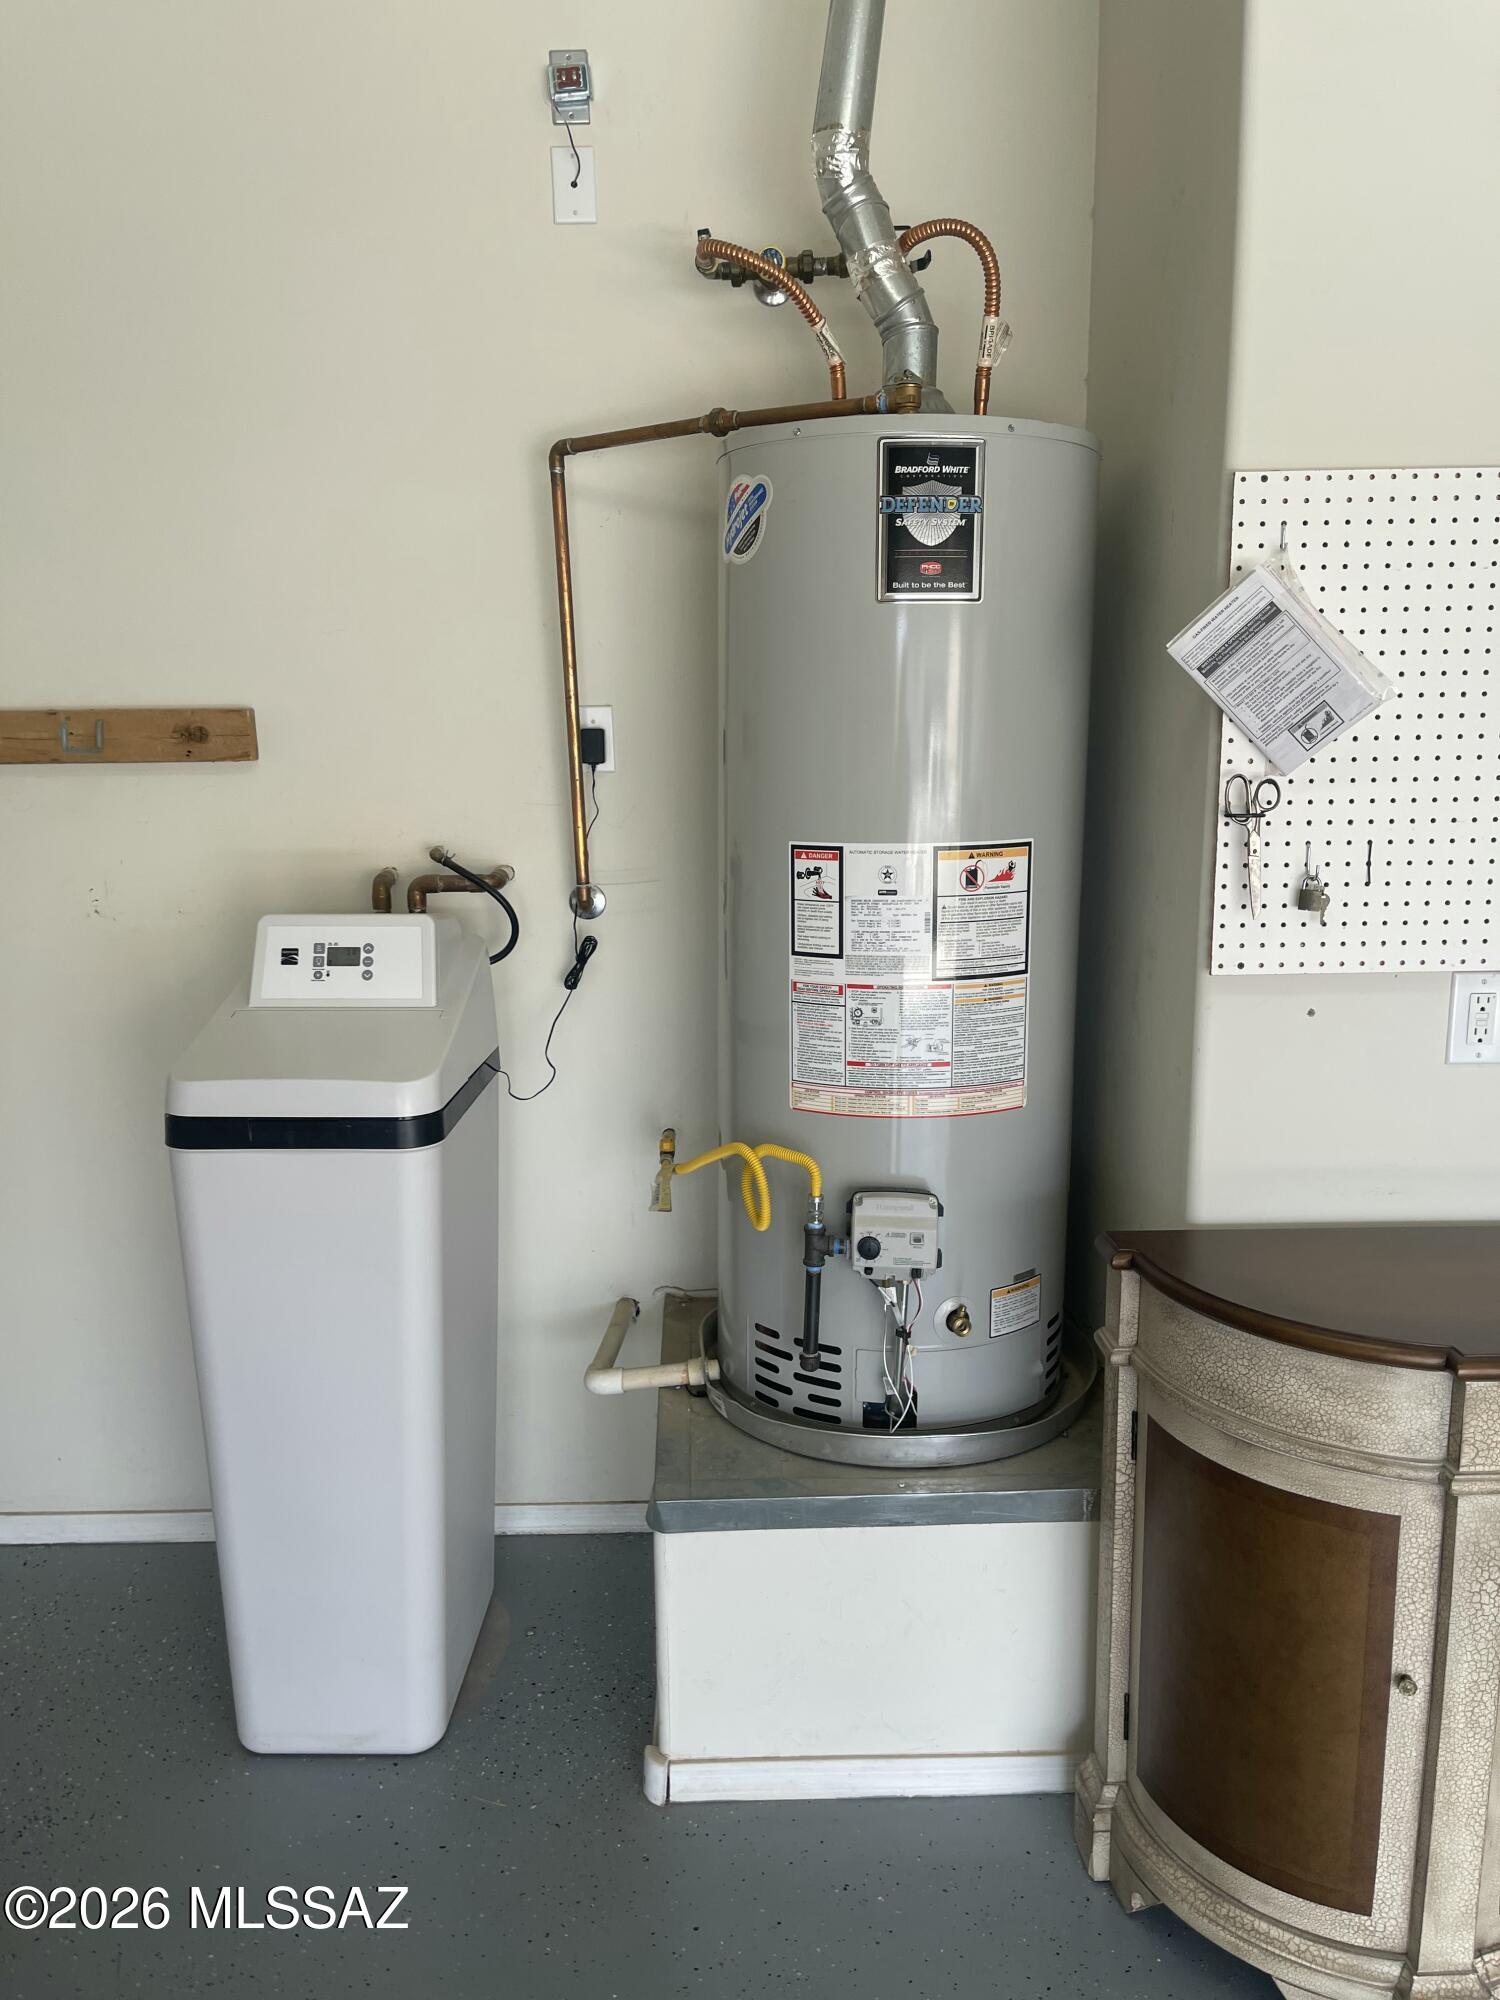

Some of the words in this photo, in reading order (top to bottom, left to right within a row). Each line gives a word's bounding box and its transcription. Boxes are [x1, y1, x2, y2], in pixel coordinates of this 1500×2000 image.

[894, 465, 940, 474] BRADFORD
[942, 465, 969, 474] WHITE
[880, 494, 982, 514] DEFENDER
[896, 518, 929, 527] SAFETY
[931, 518, 966, 527] SYSTEM
